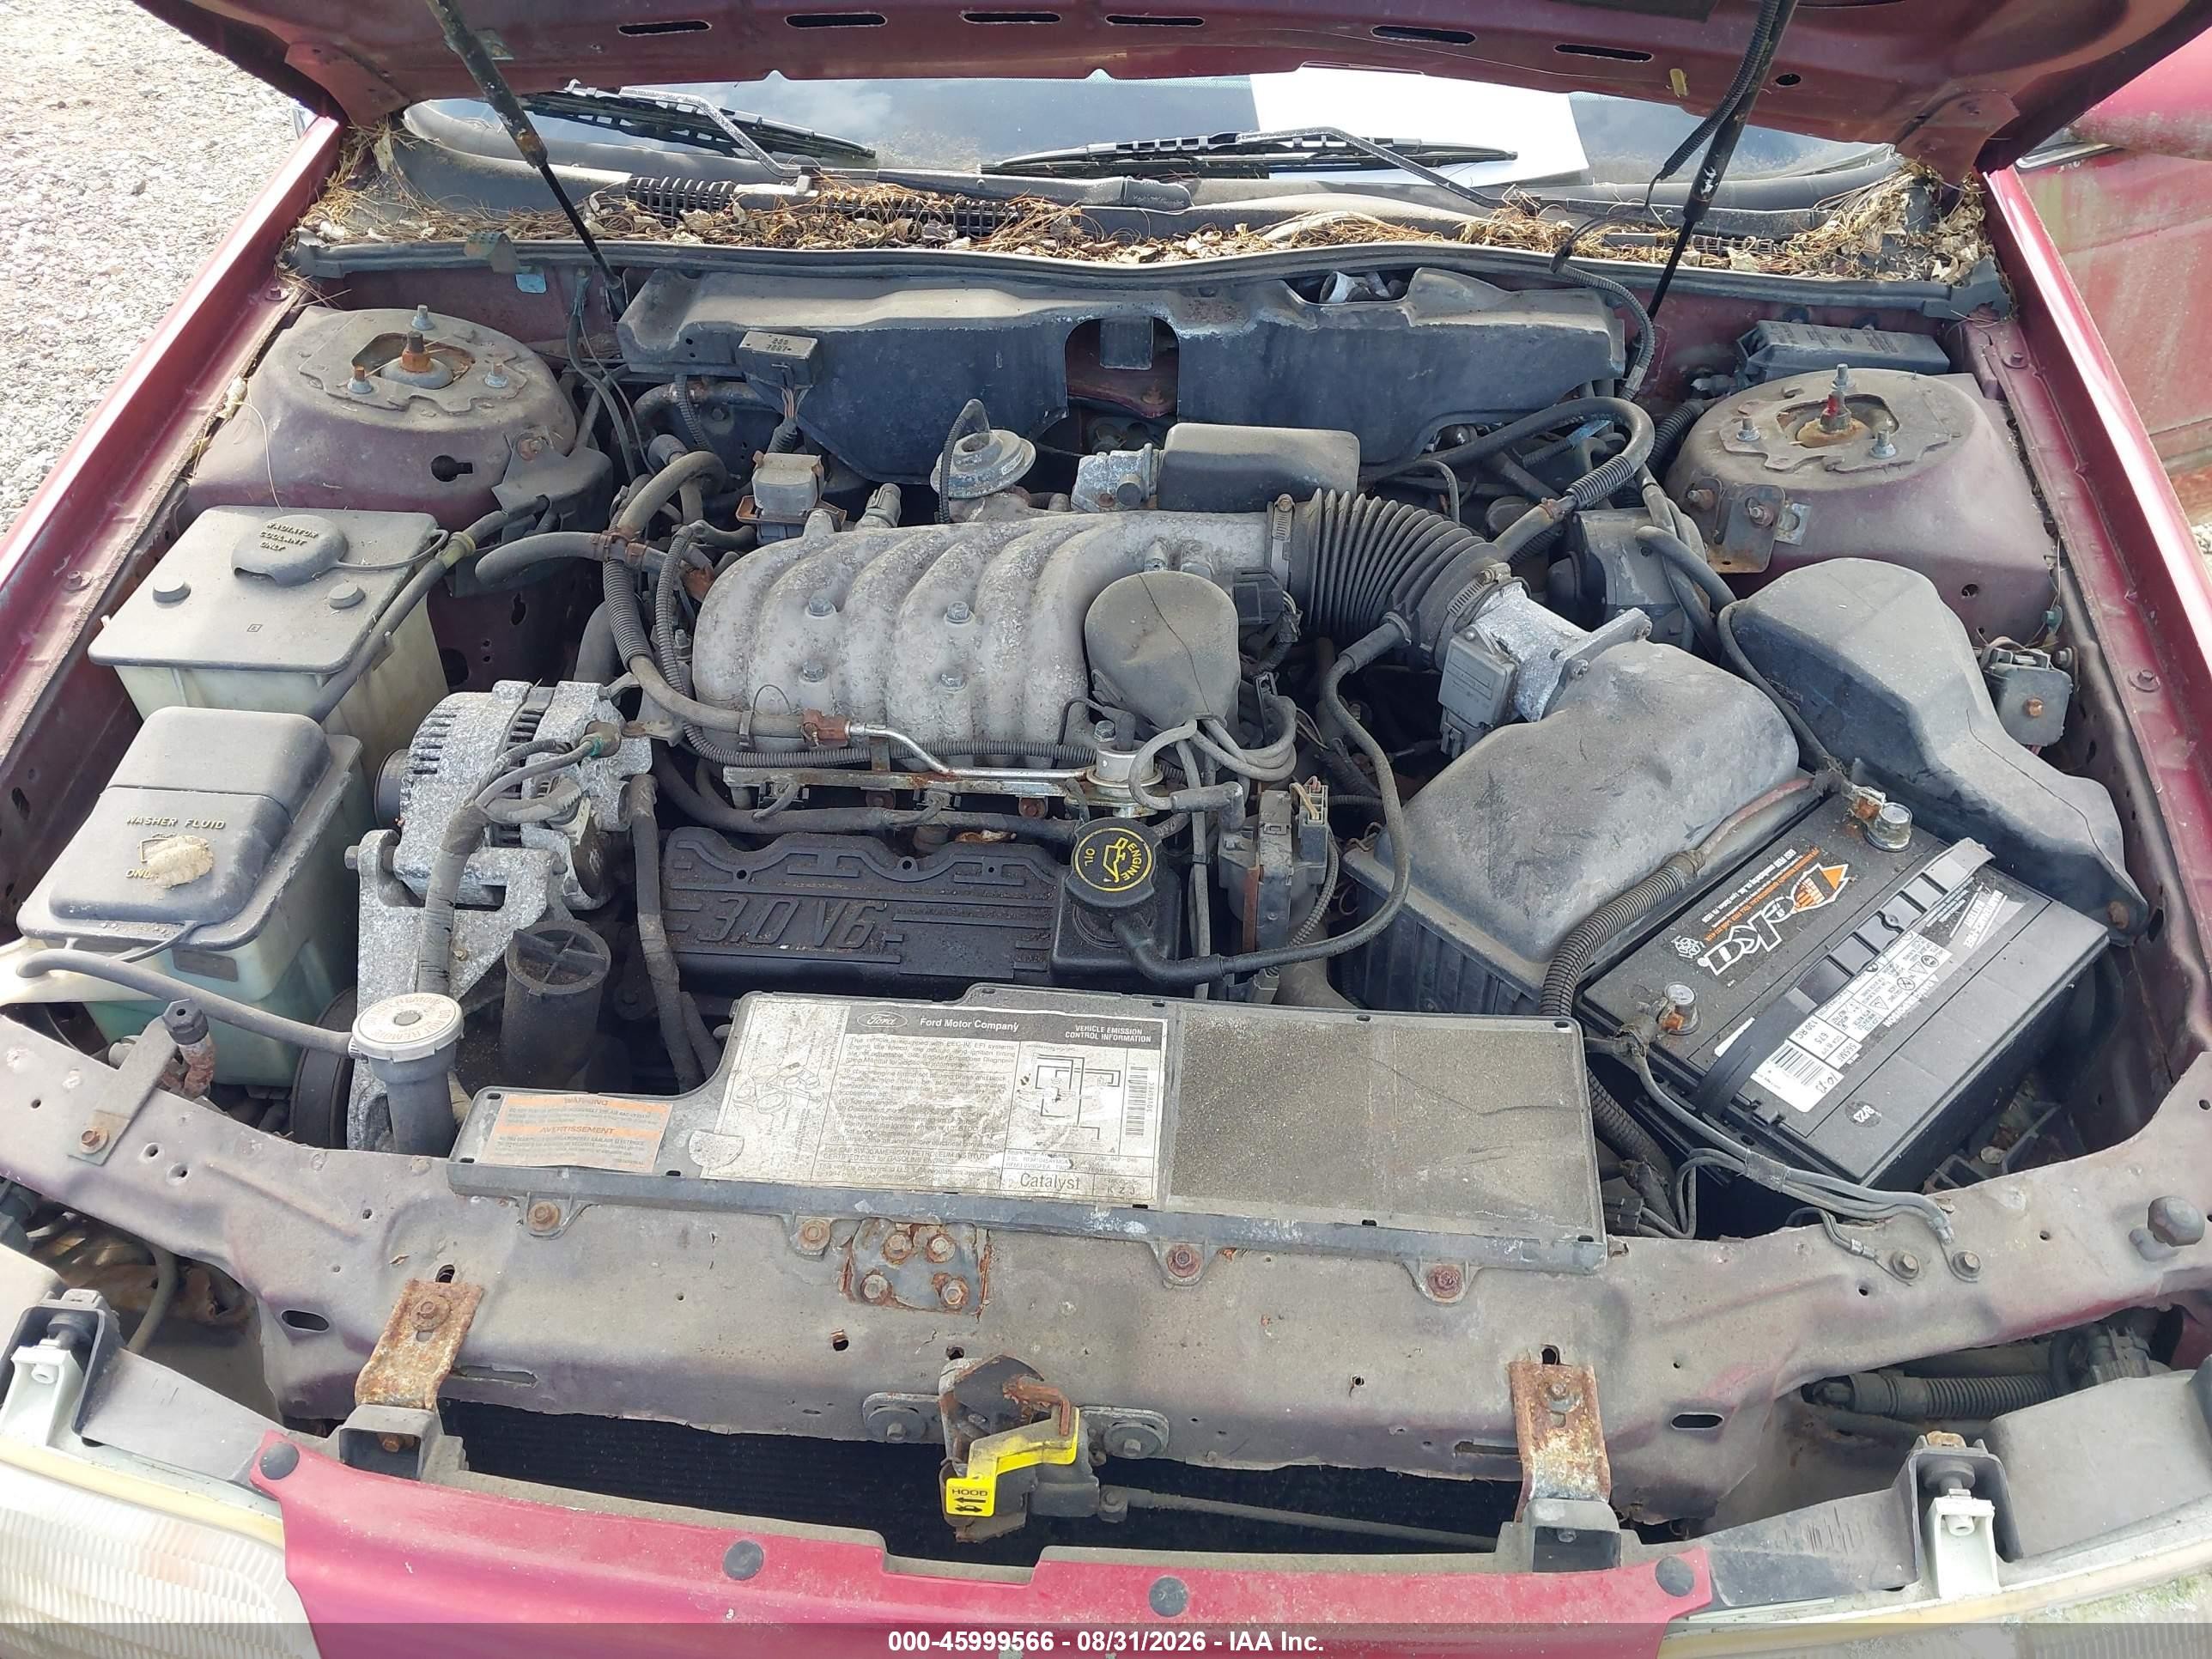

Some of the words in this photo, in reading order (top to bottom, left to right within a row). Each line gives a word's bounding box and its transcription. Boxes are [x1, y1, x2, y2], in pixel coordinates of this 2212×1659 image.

[267, 522, 319, 538] RADIATOR
[259, 532, 307, 546] COOLANT
[260, 541, 286, 551] ONLY
[125, 817, 178, 826] WASHER
[185, 818, 226, 829] FLUID
[1084, 848, 1095, 866] OIL
[1121, 842, 1142, 881] ENGINE
[814, 902, 887, 949] V6
[867, 1014, 897, 1025] Ford
[920, 1018, 942, 1027] Ford
[945, 1018, 972, 1028] Motor
[974, 1020, 1019, 1032] Company
[1805, 1019, 1817, 1030] 130
[1065, 1031, 1099, 1040] CONTROL
[1102, 1034, 1152, 1042] INFORMATION
[1075, 1024, 1105, 1033] VEHICLE
[1107, 1026, 1143, 1035] EMISSION
[1796, 1029, 1807, 1040] RC
[1851, 1104, 1875, 1124] 8/23
[1020, 1172, 1081, 1192] Catalyst
